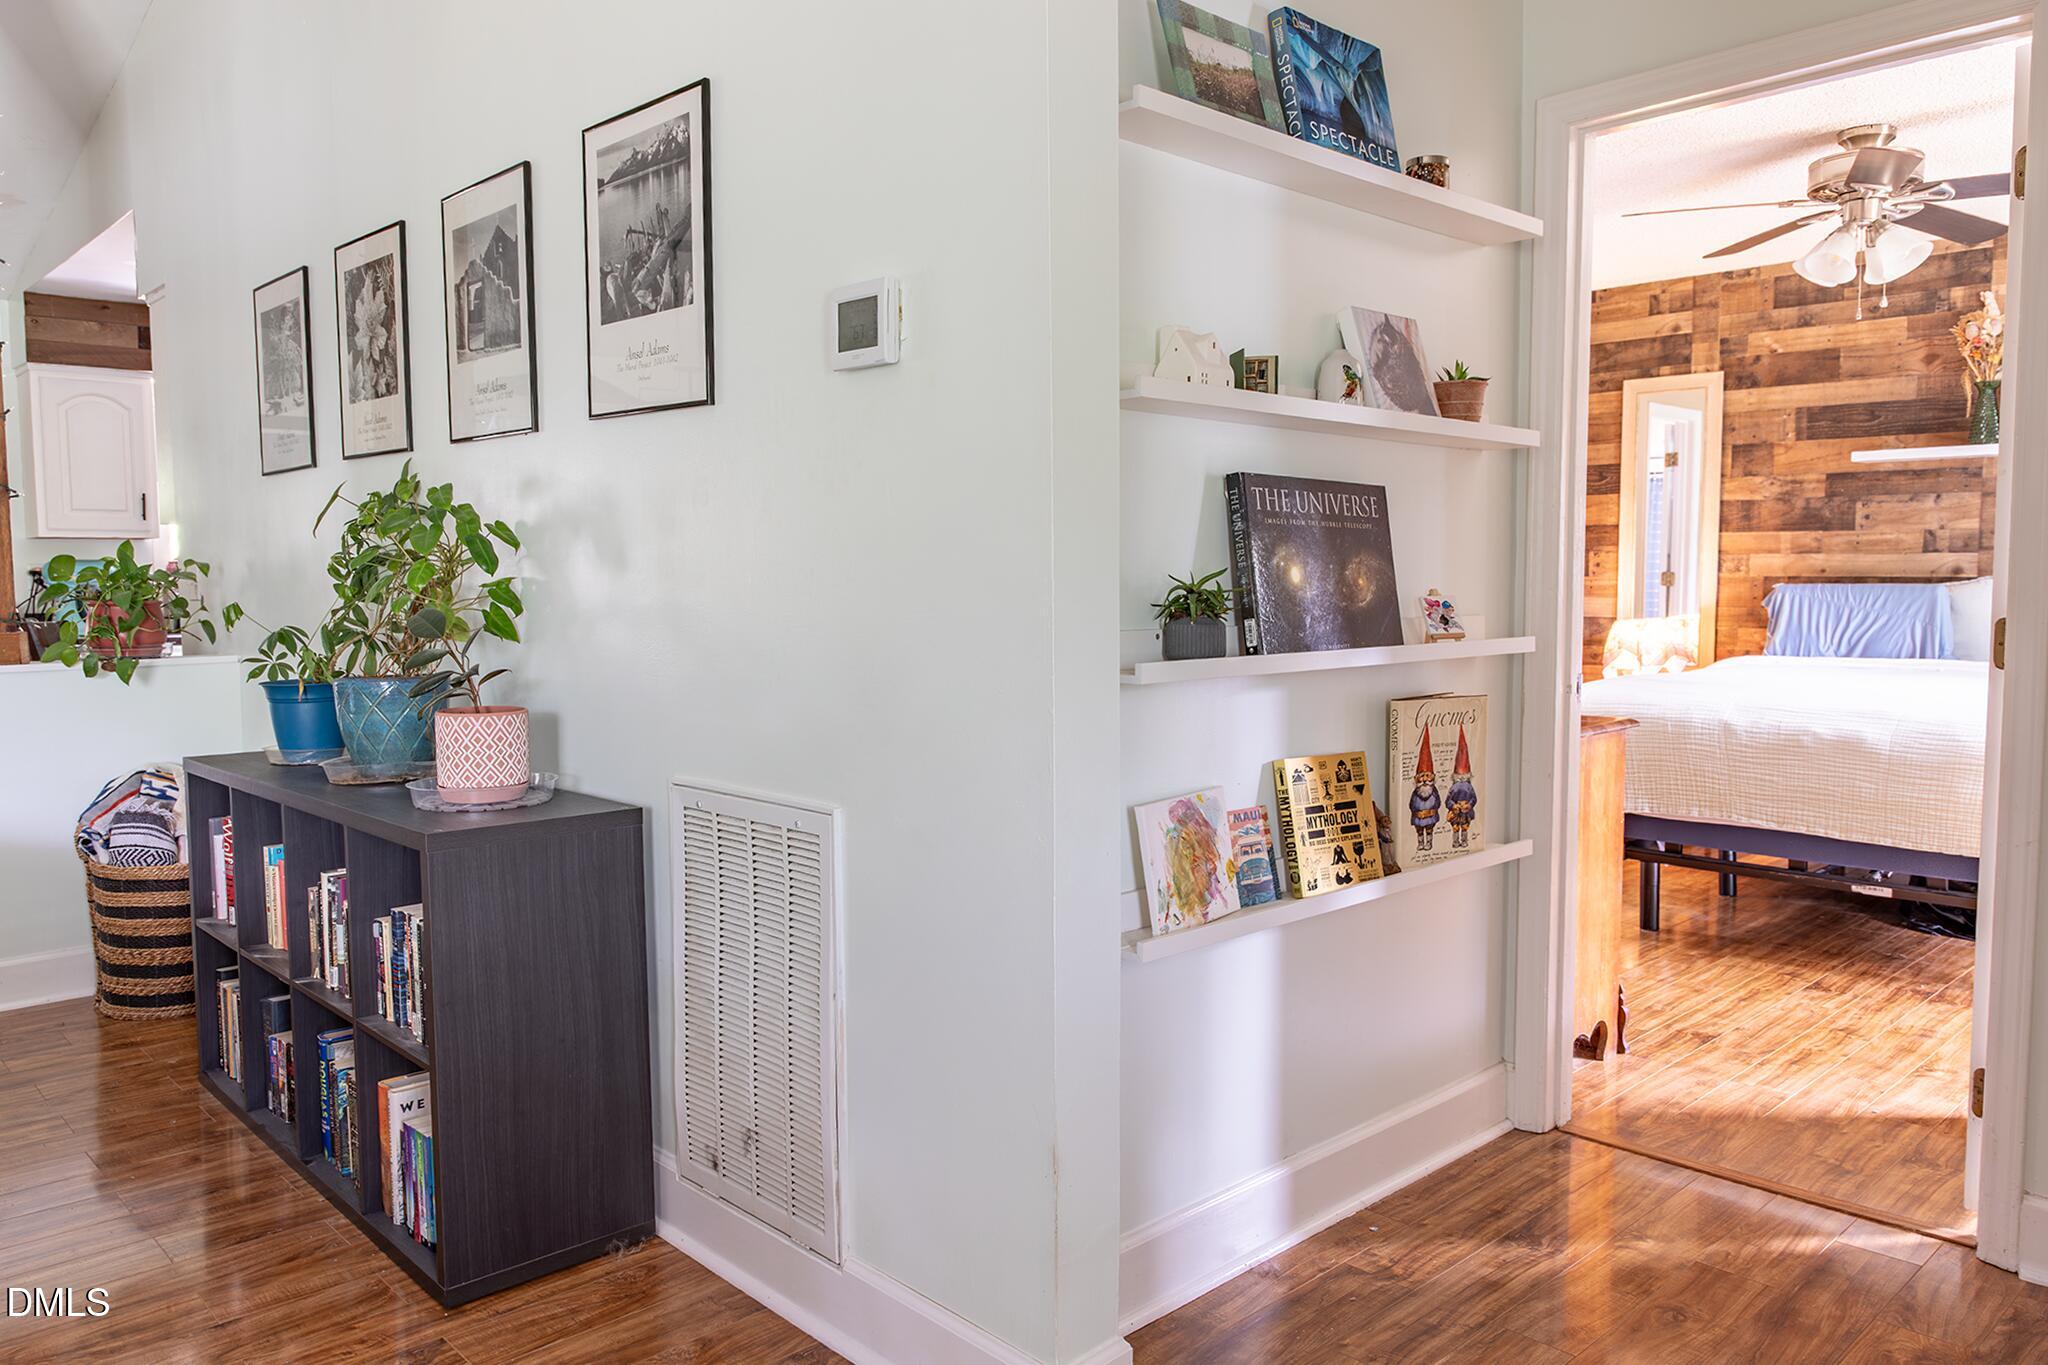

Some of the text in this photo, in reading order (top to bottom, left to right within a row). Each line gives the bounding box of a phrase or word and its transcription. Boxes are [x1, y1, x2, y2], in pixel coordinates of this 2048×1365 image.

[1309, 120, 1395, 167] SPECTACLE
[1229, 487, 1239, 511] THE
[1250, 487, 1379, 518] THE UNIVERSE
[1232, 512, 1246, 569] UNIVERSE
[1391, 708, 1399, 751] GNOMES
[1415, 701, 1477, 746] Gnomes
[1233, 808, 1261, 824] MAUI
[1279, 796, 1299, 864] MYTHOLOGY
[1305, 810, 1359, 830] MYTHOLOGY
[222, 819, 234, 864] Wolf
